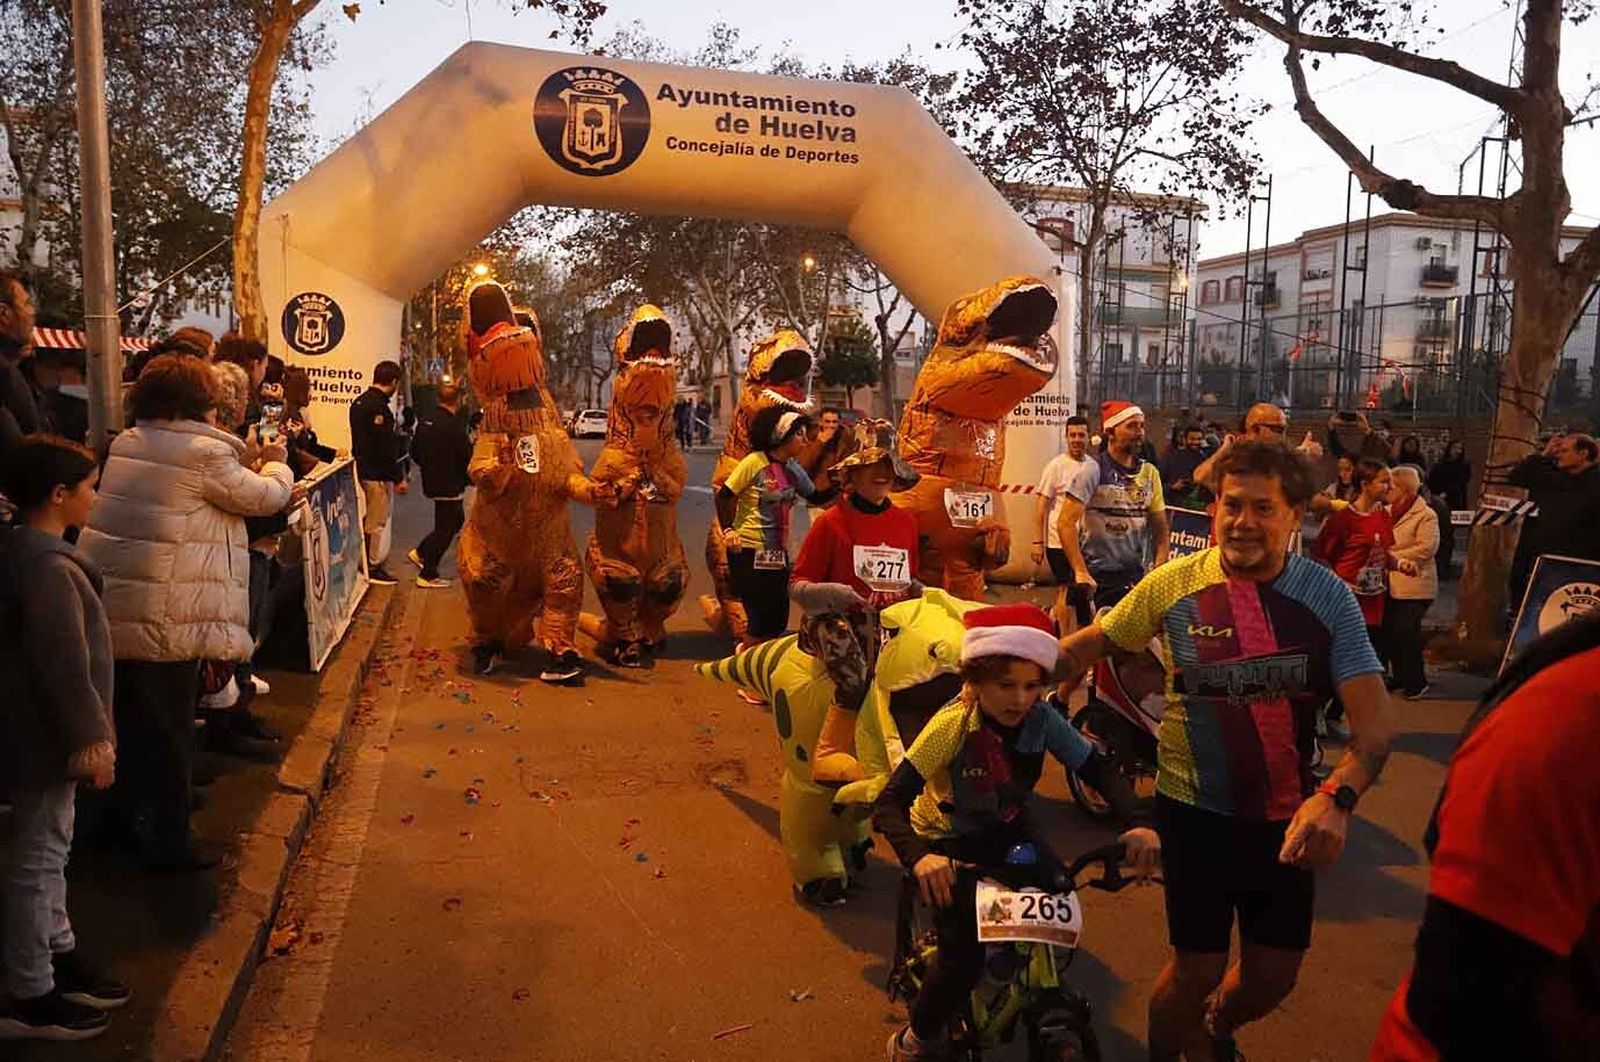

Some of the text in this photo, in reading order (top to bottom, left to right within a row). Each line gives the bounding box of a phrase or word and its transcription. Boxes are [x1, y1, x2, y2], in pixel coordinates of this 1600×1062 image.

[656, 83, 856, 118] Ayuntamiento
[715, 111, 857, 143] de Huelva
[665, 136, 860, 165] Concejalía de Deportes
[307, 366, 363, 381] miento
[1013, 405, 1070, 417] de Huelva
[963, 502, 987, 518] 161
[1170, 530, 1212, 549] ntami
[876, 560, 904, 579] 277
[1020, 895, 1072, 923] 265
